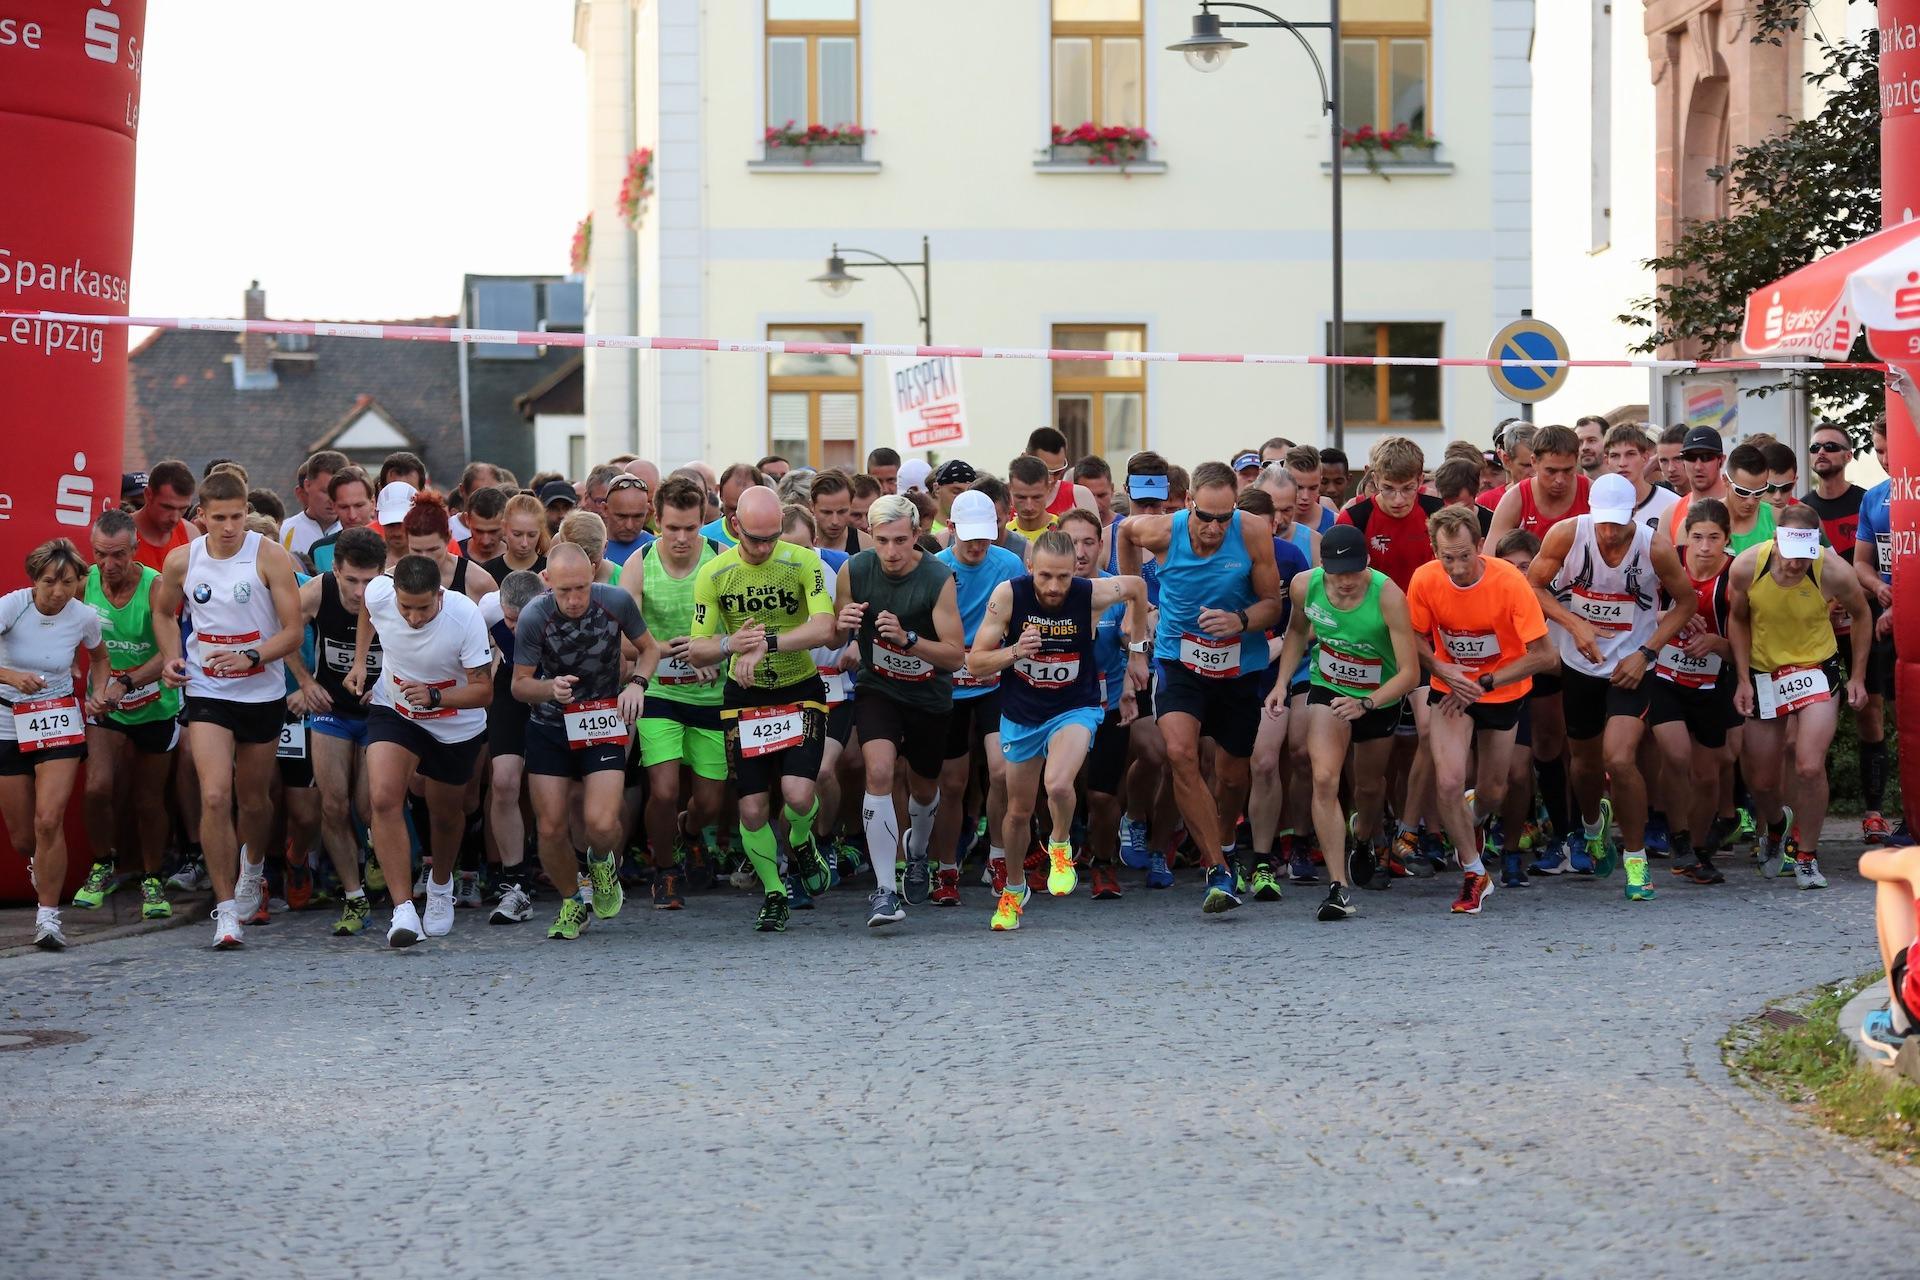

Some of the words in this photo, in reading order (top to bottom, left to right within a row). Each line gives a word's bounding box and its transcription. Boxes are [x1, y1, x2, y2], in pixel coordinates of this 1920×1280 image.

[0, 249, 127, 304] Sparkasse
[746, 585, 776, 597] Fair
[1582, 603, 1621, 616] 4374
[1028, 615, 1072, 626] VERDÄCHTIG
[1022, 622, 1048, 634] GTE
[1050, 625, 1077, 636] JOBS!
[1448, 641, 1484, 652] 4317
[338, 652, 376, 666] 58
[884, 655, 922, 670] 4323
[1192, 648, 1230, 664] 4367
[1670, 654, 1708, 668] 4448
[1022, 663, 1070, 682] 110
[1328, 662, 1368, 678] 4181
[1780, 676, 1813, 696] 4430
[30, 714, 70, 732] 4179
[578, 715, 617, 730] 4190
[752, 720, 791, 738] 4234
[588, 730, 612, 738] Michael
